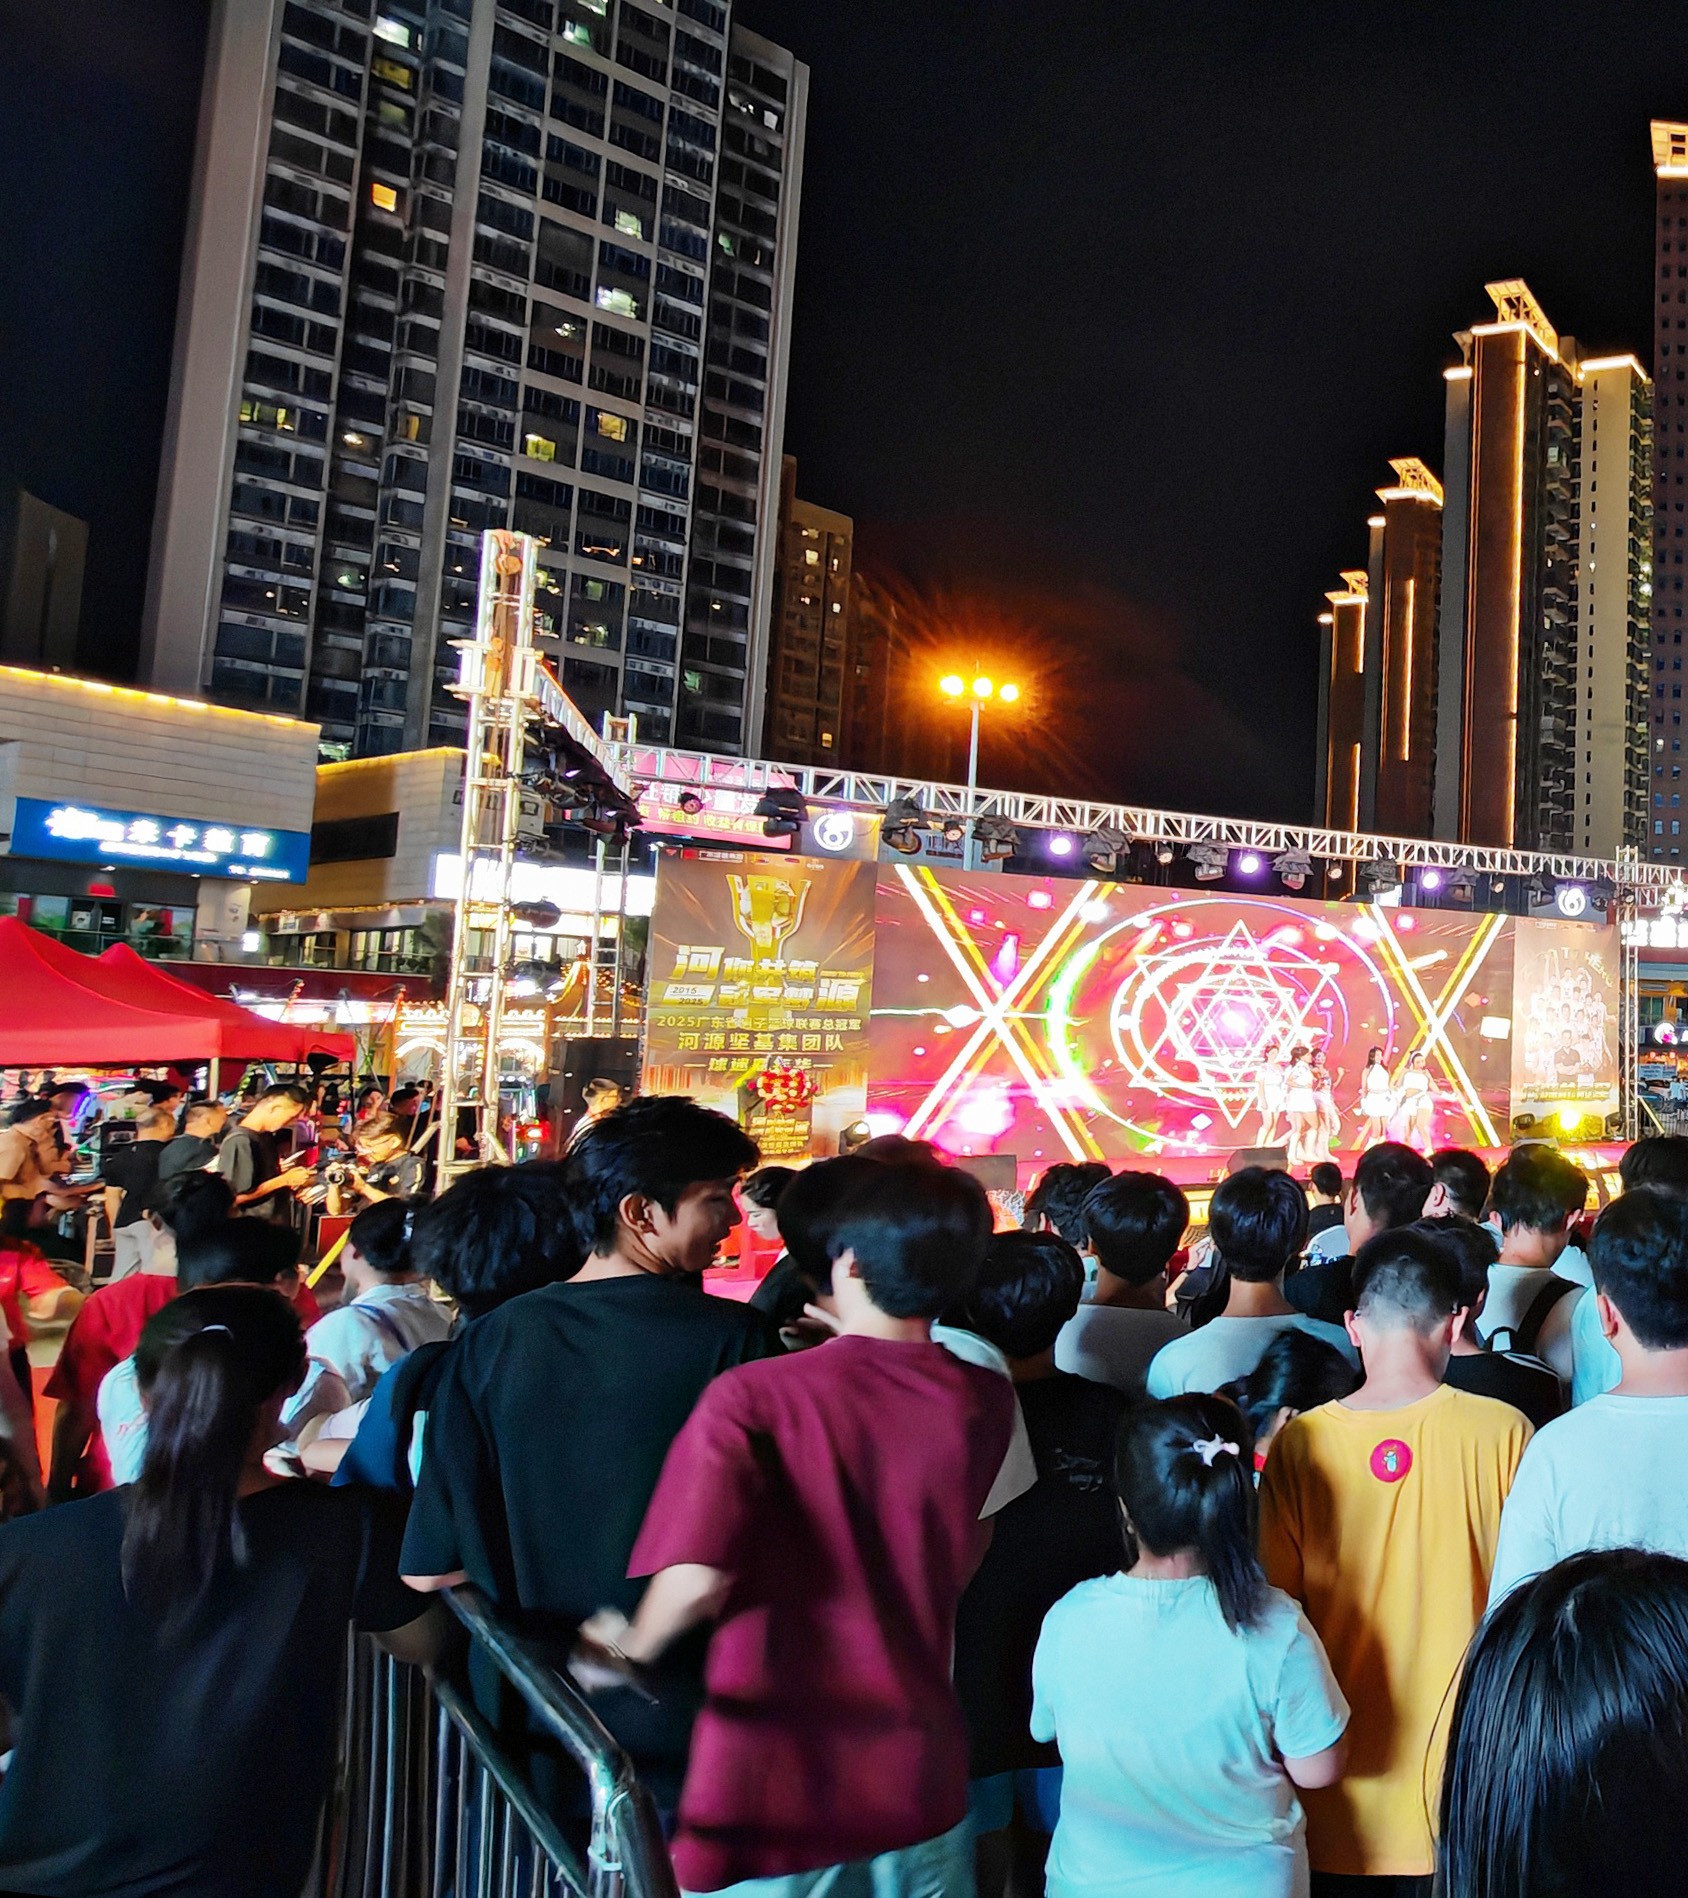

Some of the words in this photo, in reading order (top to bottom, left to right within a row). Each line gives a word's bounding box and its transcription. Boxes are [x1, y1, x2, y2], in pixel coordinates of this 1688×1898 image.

[677, 1032, 844, 1051] 河源坚基集团队
